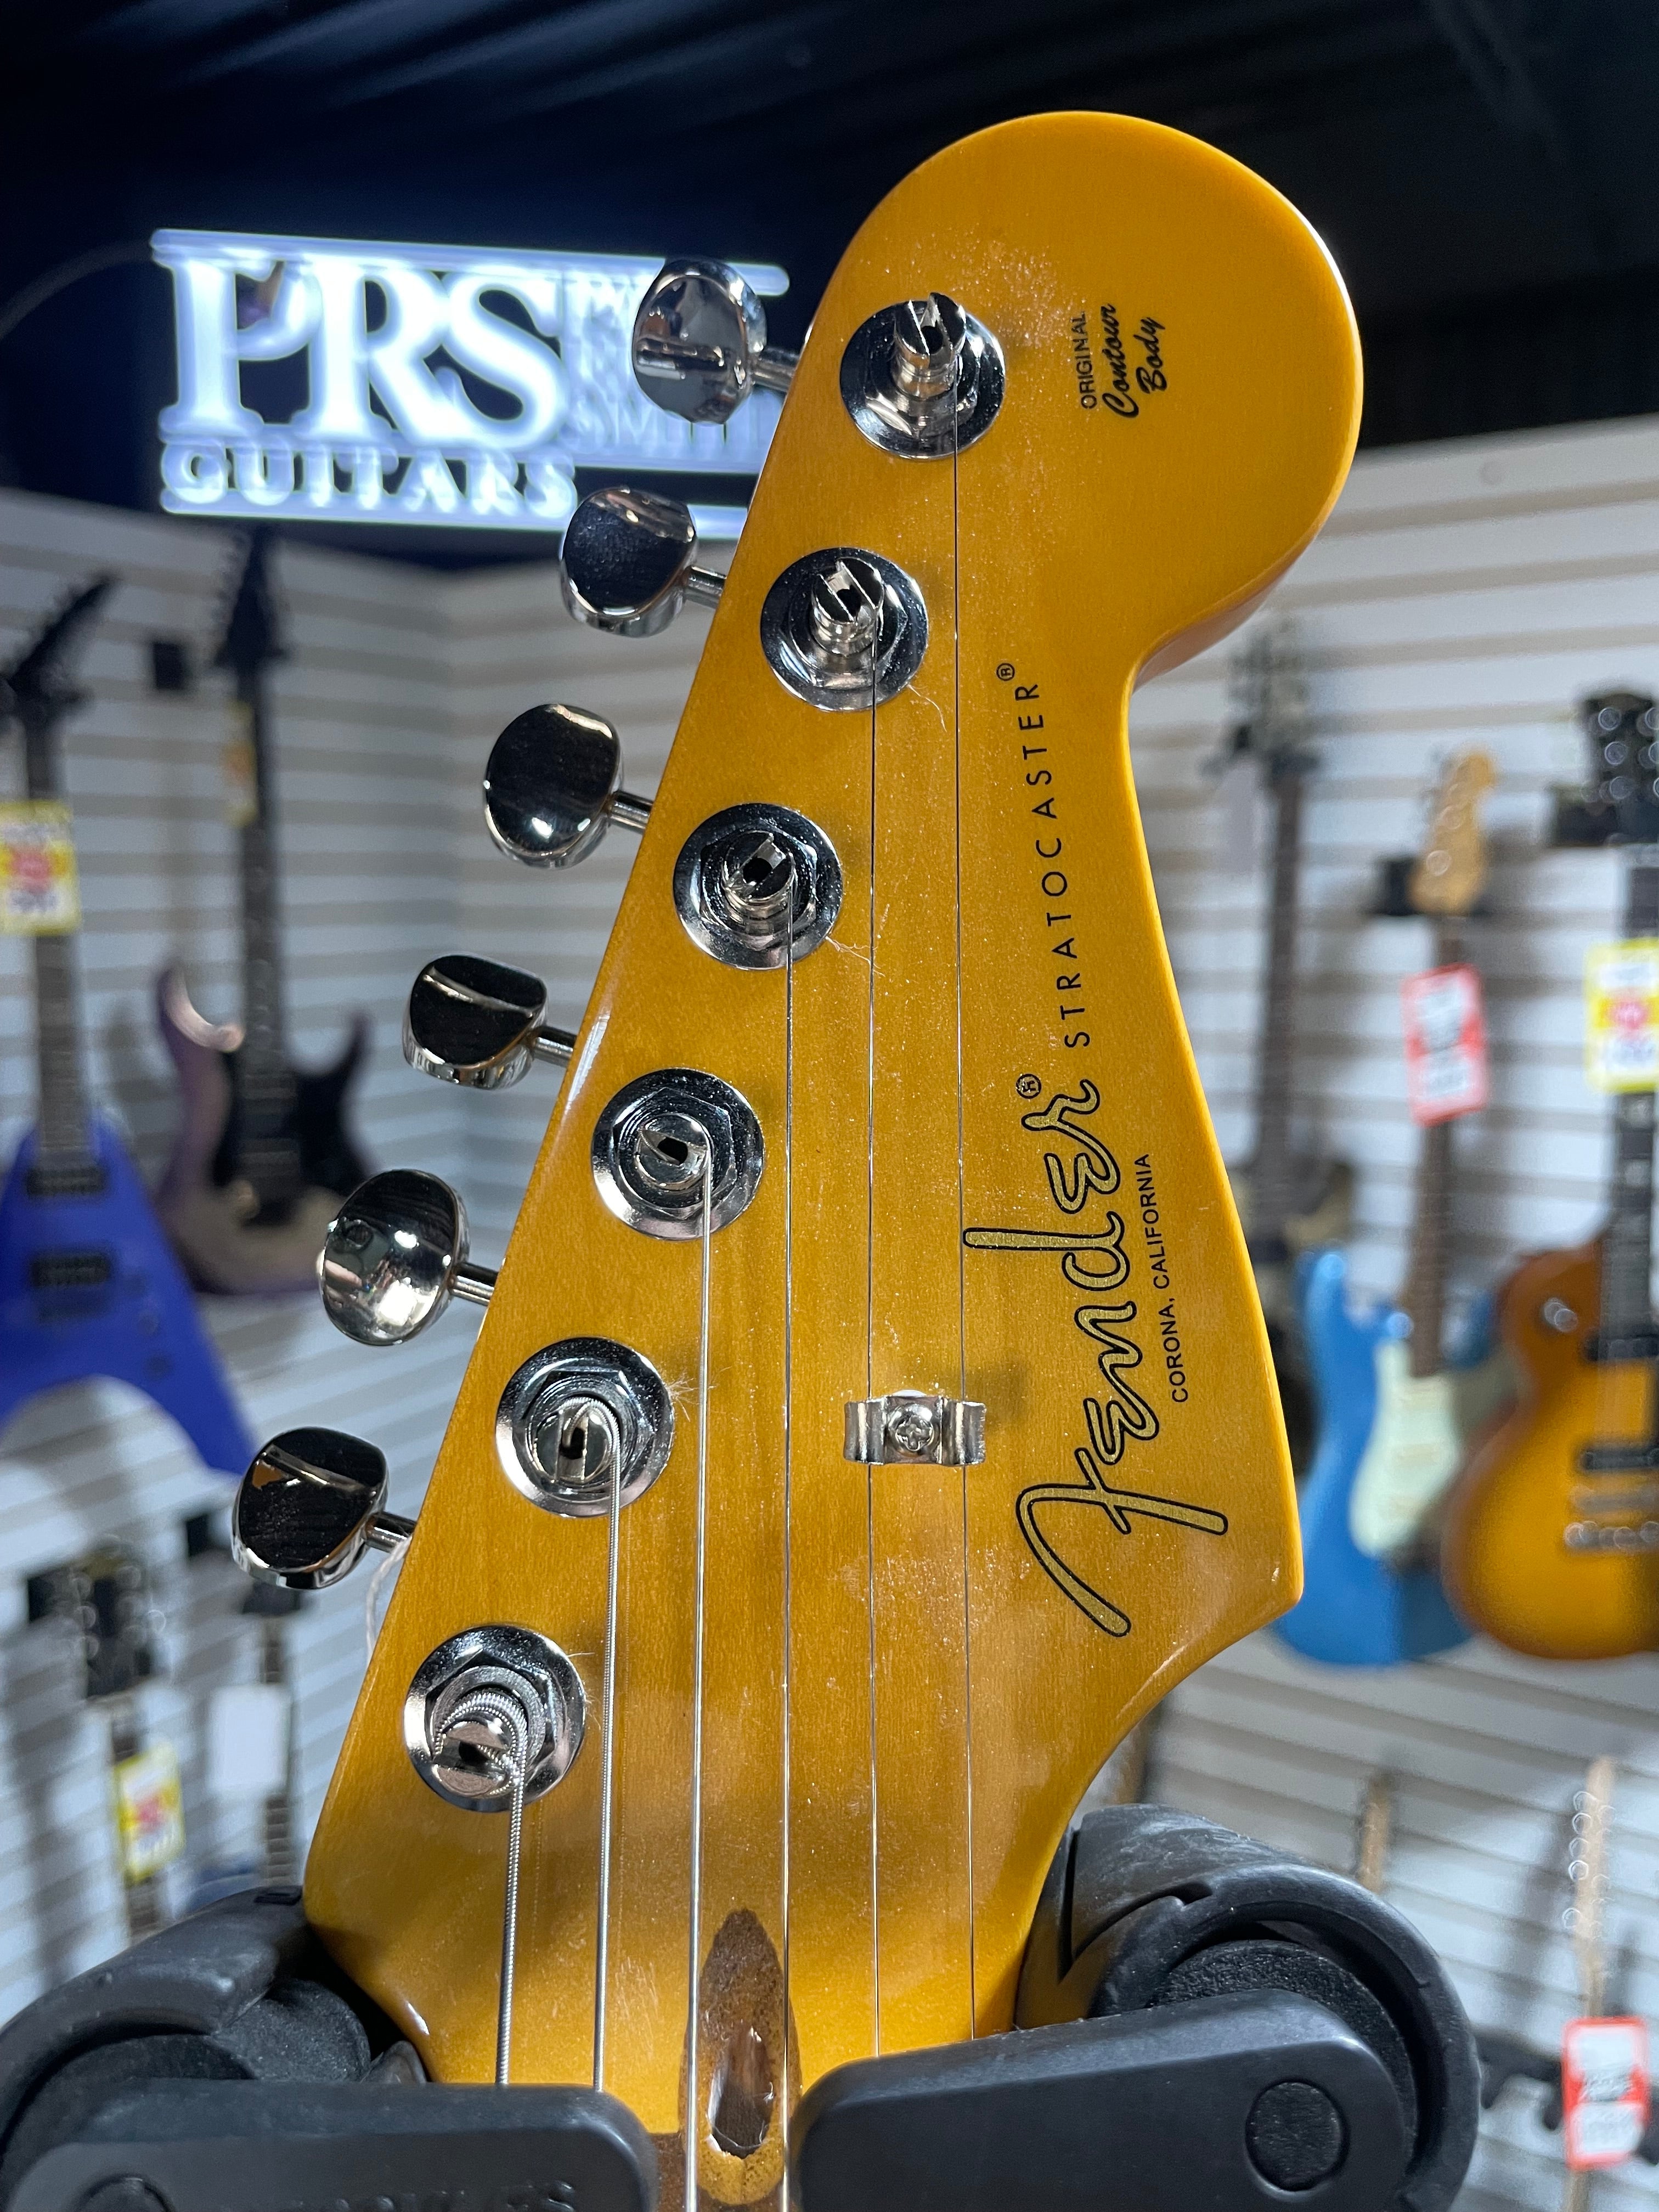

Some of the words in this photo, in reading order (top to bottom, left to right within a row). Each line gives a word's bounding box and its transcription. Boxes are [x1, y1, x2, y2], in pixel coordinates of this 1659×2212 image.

[156, 244, 572, 453] PRS
[1070, 311, 1097, 409] ORIGINAL
[1101, 303, 1139, 418] Contour
[1133, 317, 1167, 394] Body
[160, 439, 577, 518] GUITARS
[1135, 1154, 1170, 1289] CALIFORNIA
[1158, 1297, 1188, 1403] CORONA,
